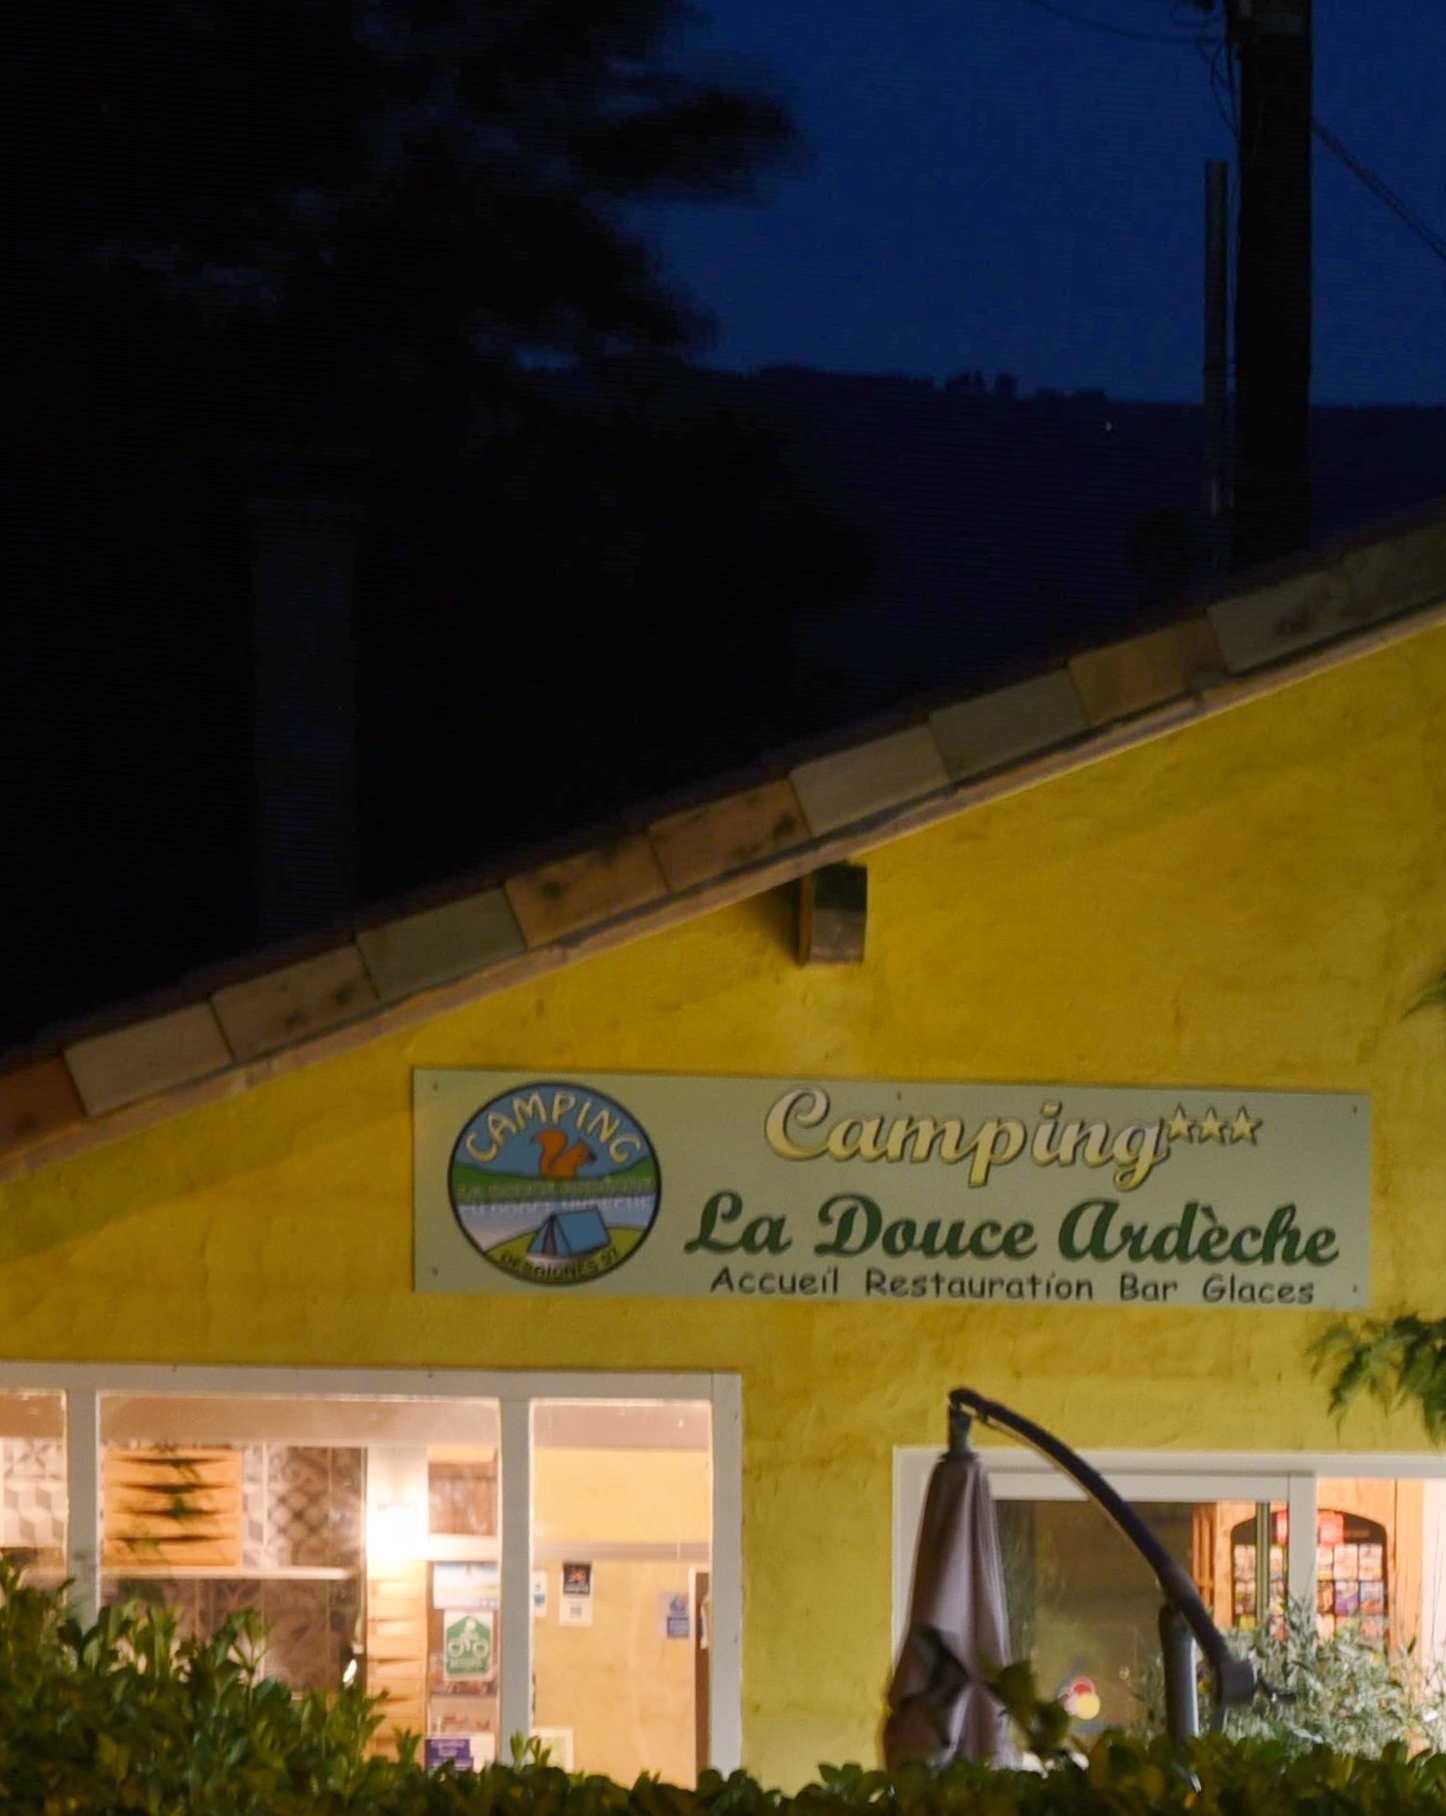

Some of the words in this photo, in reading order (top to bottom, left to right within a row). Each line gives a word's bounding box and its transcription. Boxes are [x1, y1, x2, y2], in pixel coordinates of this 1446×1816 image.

[466, 1091, 642, 1164] CAMPING
[764, 1085, 1171, 1192] Camping
[684, 1189, 792, 1256] La
[814, 1192, 1038, 1261] Douce
[1058, 1198, 1340, 1267] Ardèche
[710, 1266, 839, 1296] Accueil
[865, 1267, 1094, 1301] Restauration
[1119, 1273, 1178, 1302] Bar
[1202, 1274, 1314, 1305] Glaces
